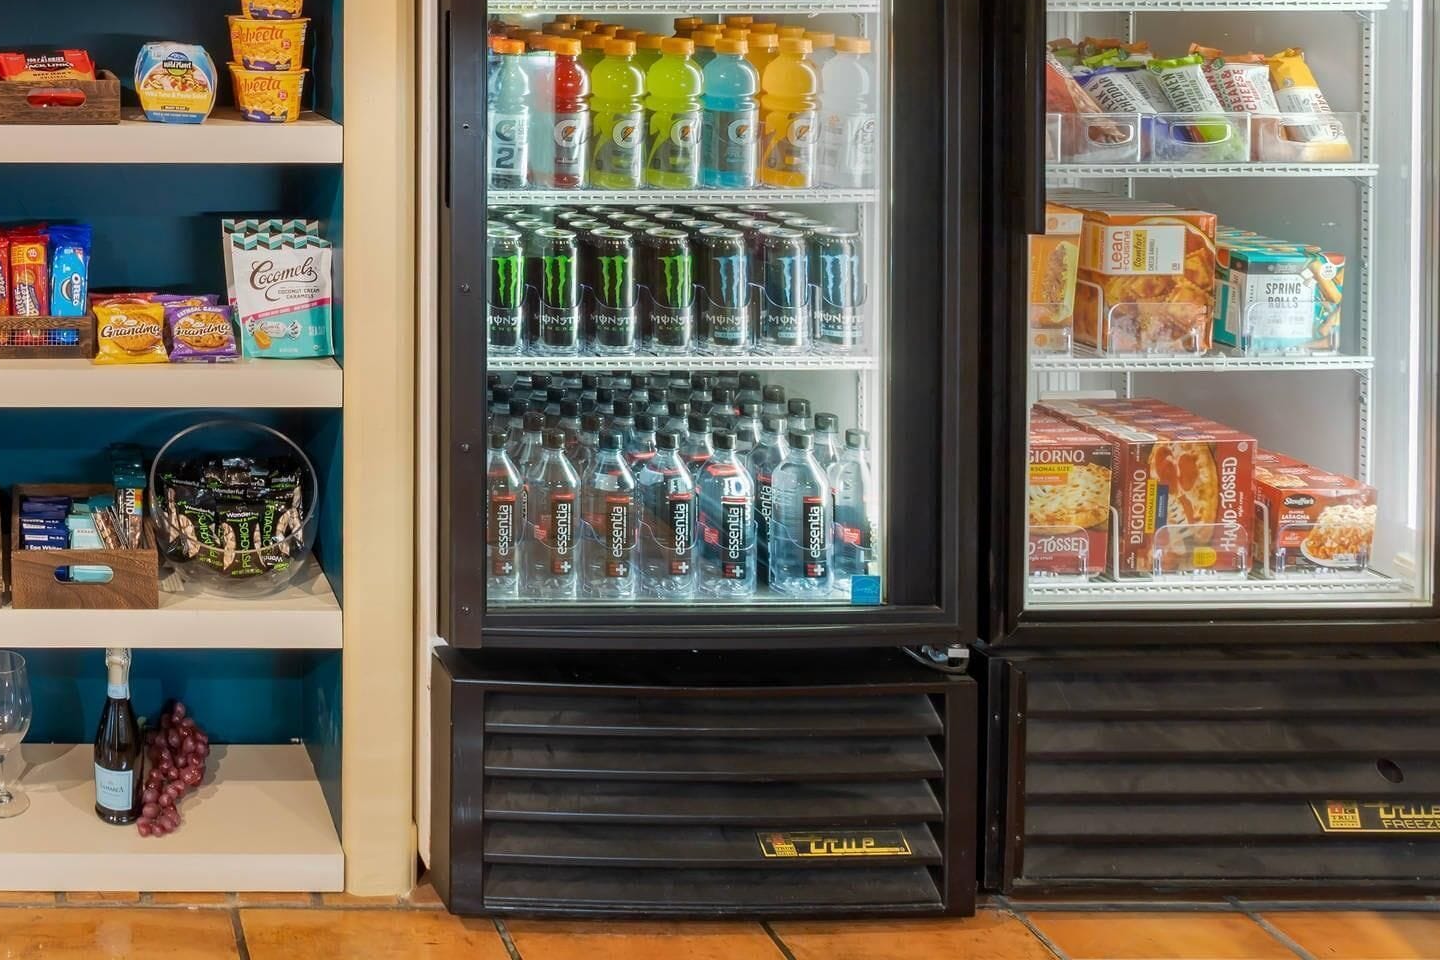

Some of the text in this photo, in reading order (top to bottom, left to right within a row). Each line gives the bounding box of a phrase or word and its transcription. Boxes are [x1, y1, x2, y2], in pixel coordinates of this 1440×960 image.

[164, 61, 192, 69] Wild Planet
[1161, 73, 1194, 113] CHICKEN
[1223, 80, 1245, 113] BEAN
[1233, 69, 1258, 111] CHEESE
[1111, 230, 1123, 270] Lean
[1133, 233, 1142, 268] Comfort
[71, 273, 82, 306] OREO
[250, 256, 318, 296] Cocomels
[1265, 283, 1302, 295] SPRING
[1267, 296, 1299, 309] ROLLS
[1029, 449, 1085, 463] GIORNO
[126, 488, 136, 515] KIND
[212, 486, 244, 495] Wonderful
[1130, 469, 1147, 545] DIGIORNO
[1219, 456, 1238, 552] HAND-TOSSED
[498, 504, 510, 557] essentia
[556, 502, 569, 555] essentia
[612, 505, 625, 558] essentia
[674, 502, 686, 555] essentia
[728, 506, 741, 559] essentia
[808, 505, 821, 558] essentia
[1029, 536, 1089, 555] D-TOSSED
